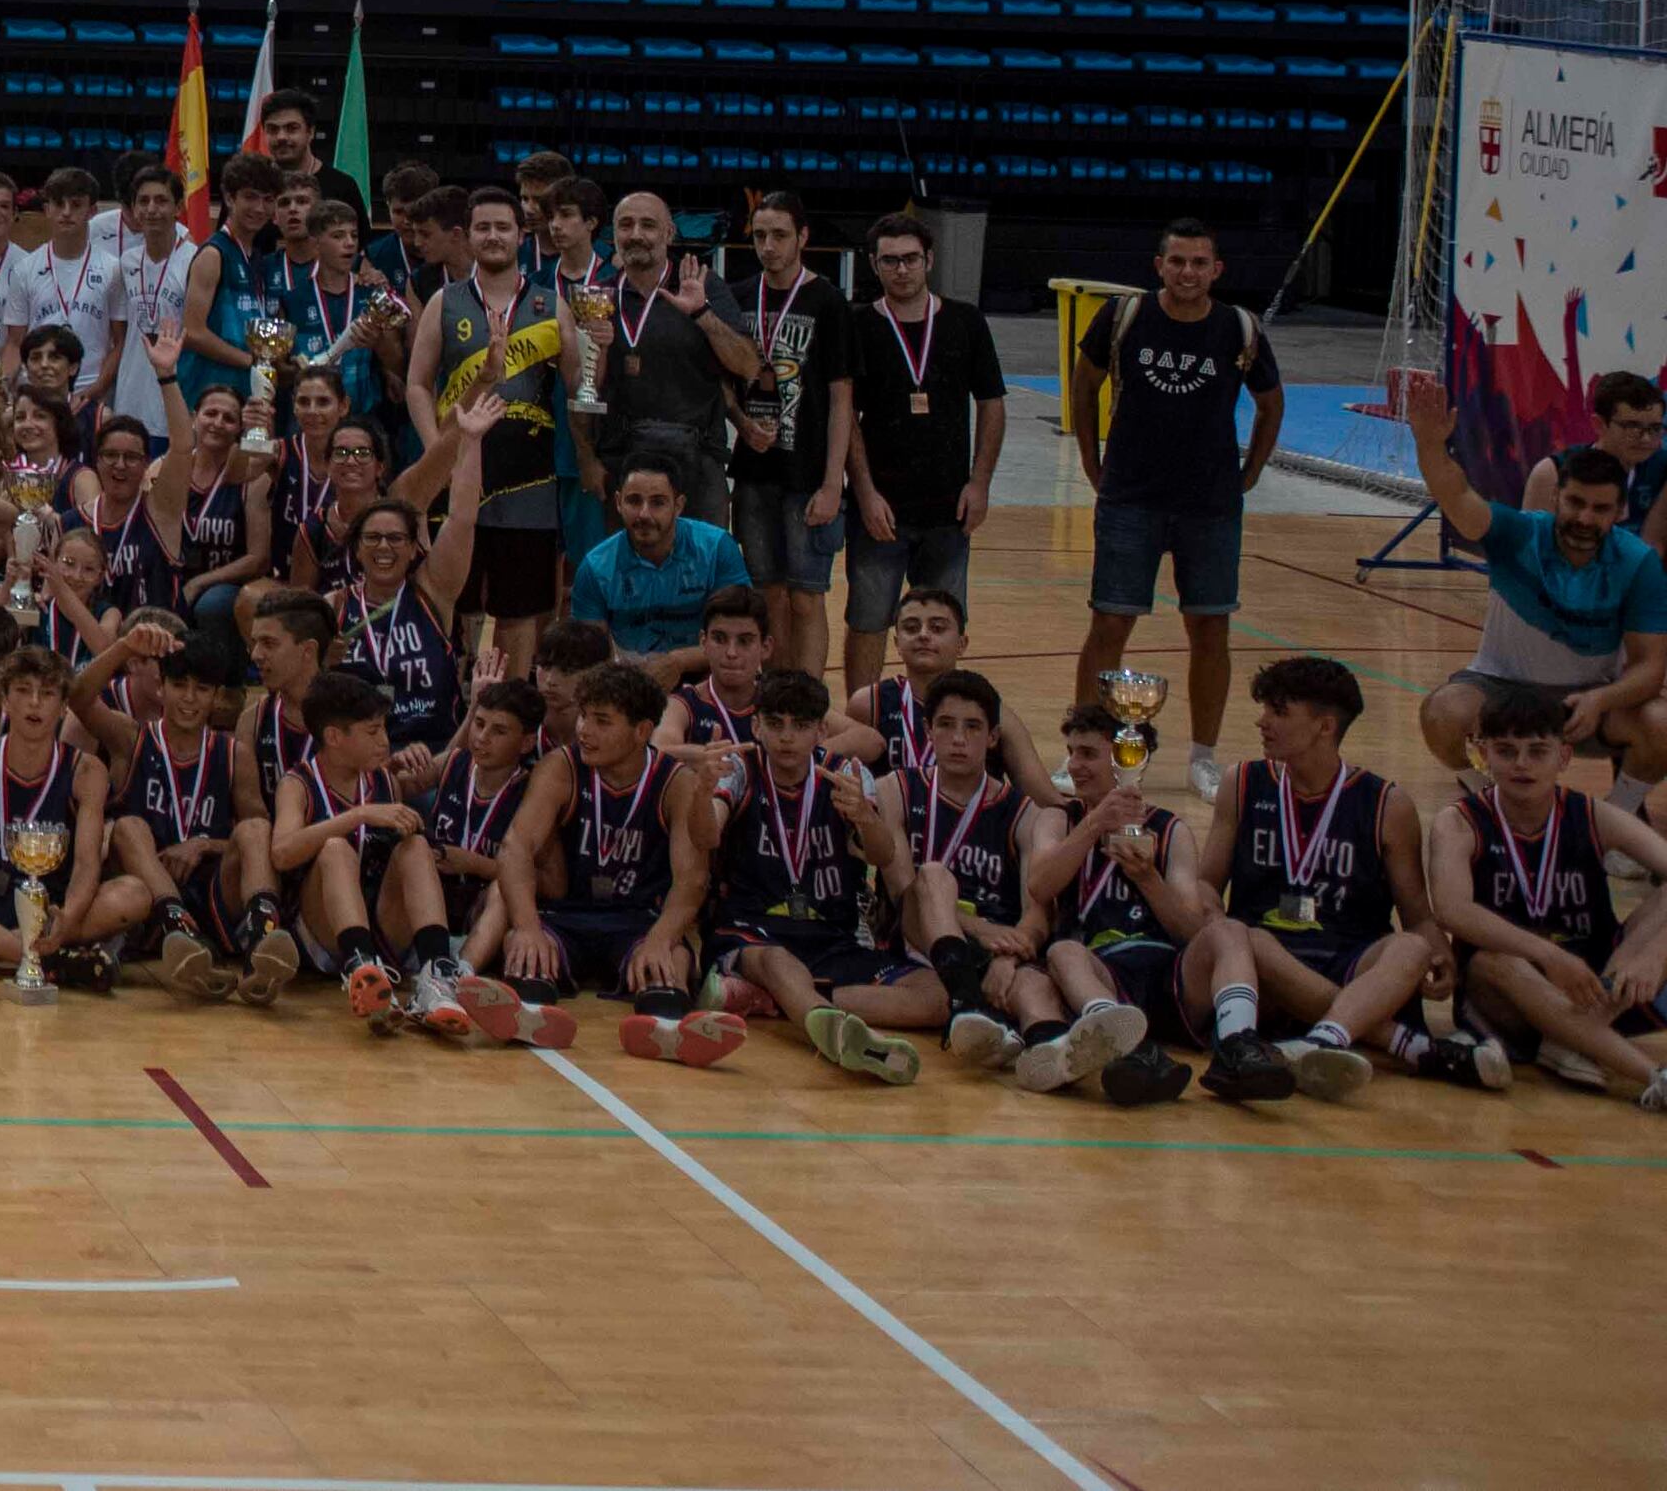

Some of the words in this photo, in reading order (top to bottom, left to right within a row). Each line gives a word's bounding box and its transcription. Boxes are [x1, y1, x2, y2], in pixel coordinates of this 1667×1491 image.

[1521, 109, 1616, 158] ALMERÍA
[1520, 151, 1569, 181] CIUDAD
[34, 299, 104, 322] SALARES
[457, 317, 472, 342] 9
[1139, 347, 1217, 376] SAFA
[199, 516, 234, 547] OYO
[399, 657, 433, 692] 73
[146, 777, 167, 815] EL
[956, 843, 1003, 884] OYO
[1252, 828, 1282, 868] EL
